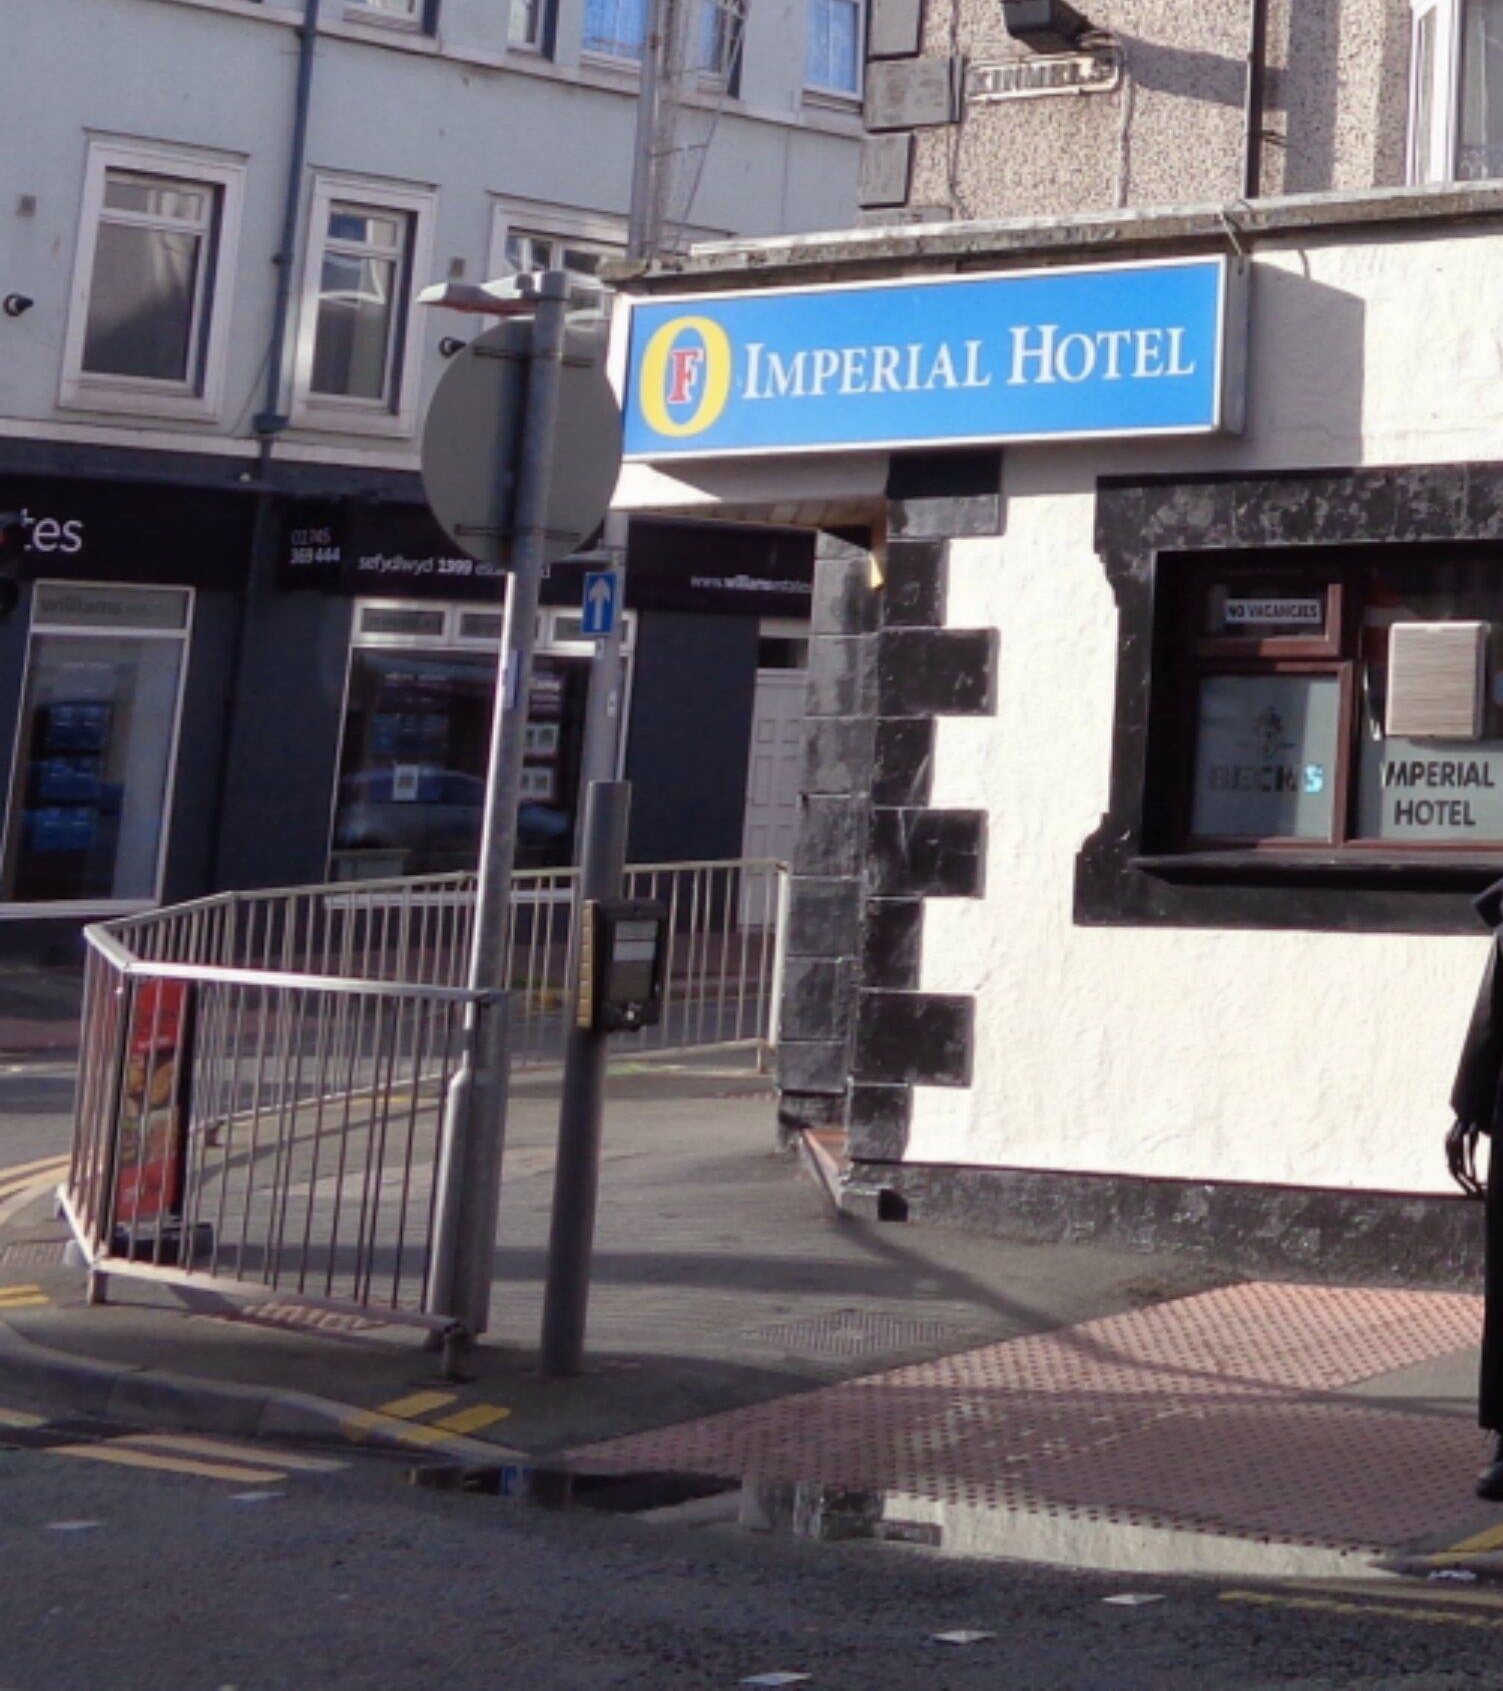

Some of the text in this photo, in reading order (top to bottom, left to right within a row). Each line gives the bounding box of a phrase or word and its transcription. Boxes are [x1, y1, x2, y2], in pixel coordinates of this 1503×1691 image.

[741, 324, 1196, 400] IMPERIAL HOTEL
[1383, 760, 1495, 790] IMPERIAL
[1394, 799, 1476, 827] HOTEL
